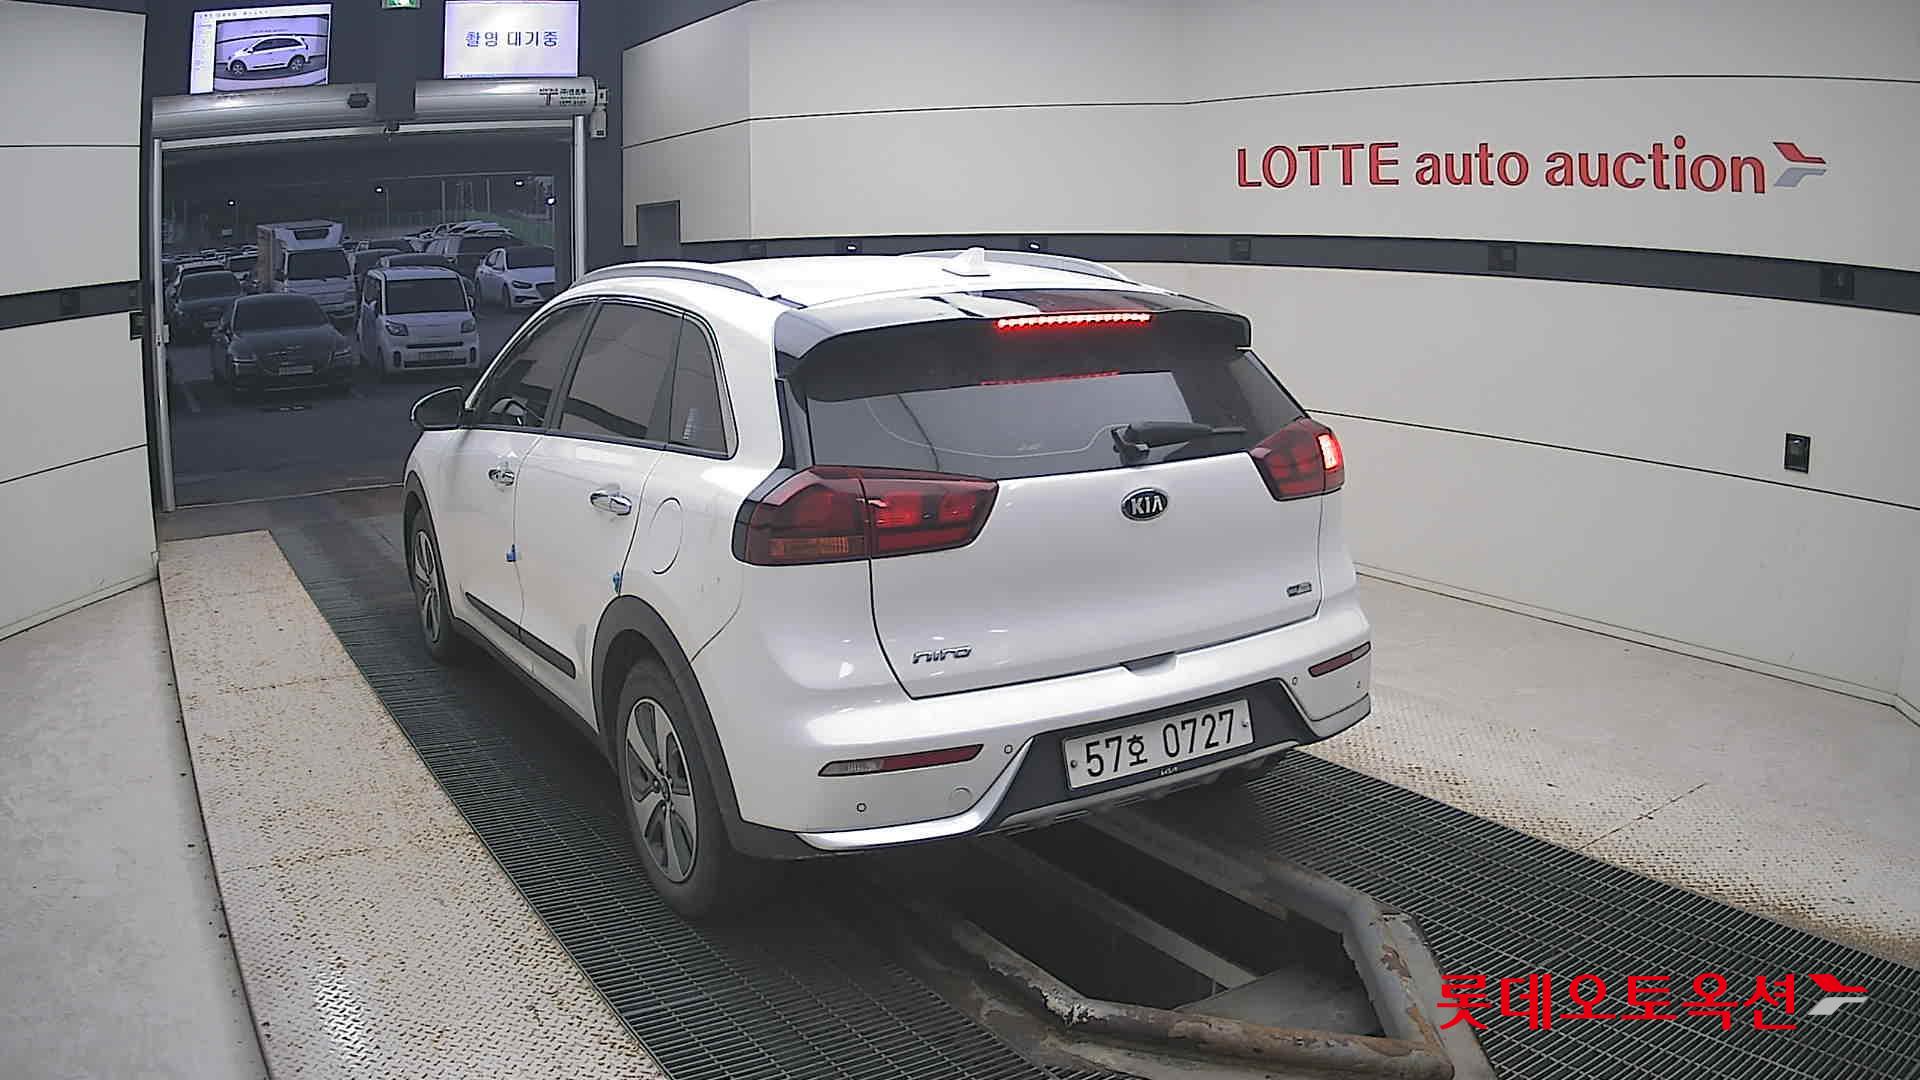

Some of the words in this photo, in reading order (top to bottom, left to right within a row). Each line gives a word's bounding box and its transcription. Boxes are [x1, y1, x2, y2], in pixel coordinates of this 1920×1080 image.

[465, 31, 499, 47] 촬영
[506, 31, 558, 48] 대기중
[1237, 142, 1399, 188] LOTTE
[1415, 143, 1529, 187] auto
[1545, 135, 1767, 194] auction
[1129, 495, 1163, 515] KIA
[1085, 734, 1148, 777] 57호
[1162, 709, 1234, 758] 0727
